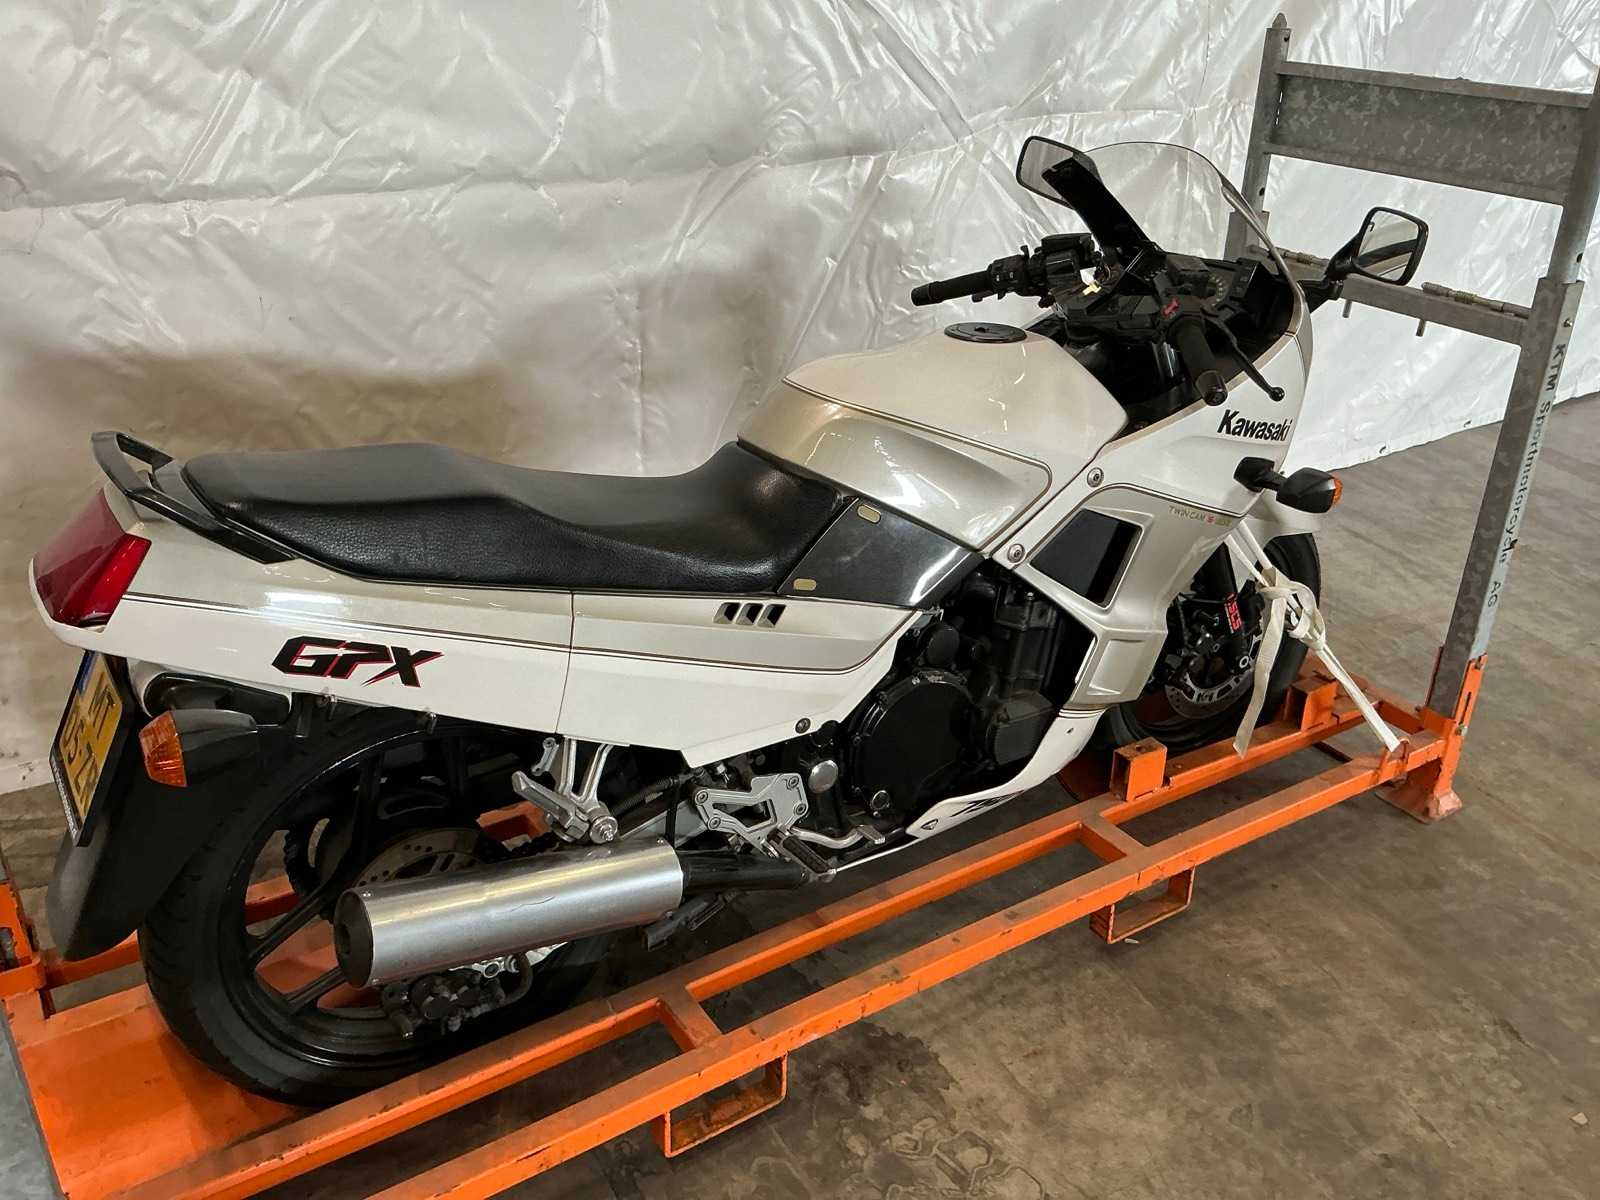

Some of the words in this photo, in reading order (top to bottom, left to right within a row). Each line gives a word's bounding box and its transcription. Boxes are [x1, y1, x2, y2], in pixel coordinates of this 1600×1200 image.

[1545, 343, 1566, 391] KTM
[1217, 409, 1293, 441] Kawasaki
[1487, 581, 1501, 607] AG
[272, 636, 445, 688] GPX
